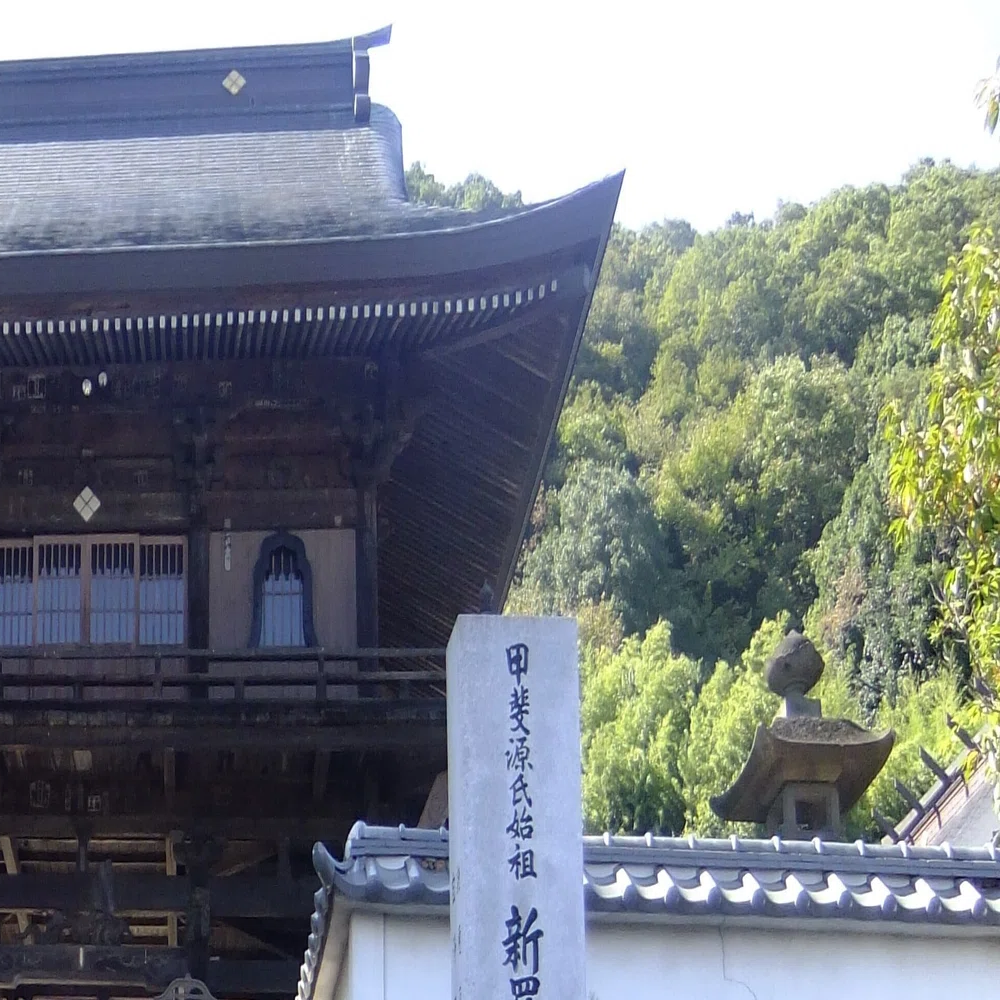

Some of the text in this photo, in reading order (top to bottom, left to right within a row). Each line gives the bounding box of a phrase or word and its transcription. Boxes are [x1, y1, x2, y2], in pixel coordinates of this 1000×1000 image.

[504, 642, 538, 881] 甲斐源氏始祖
